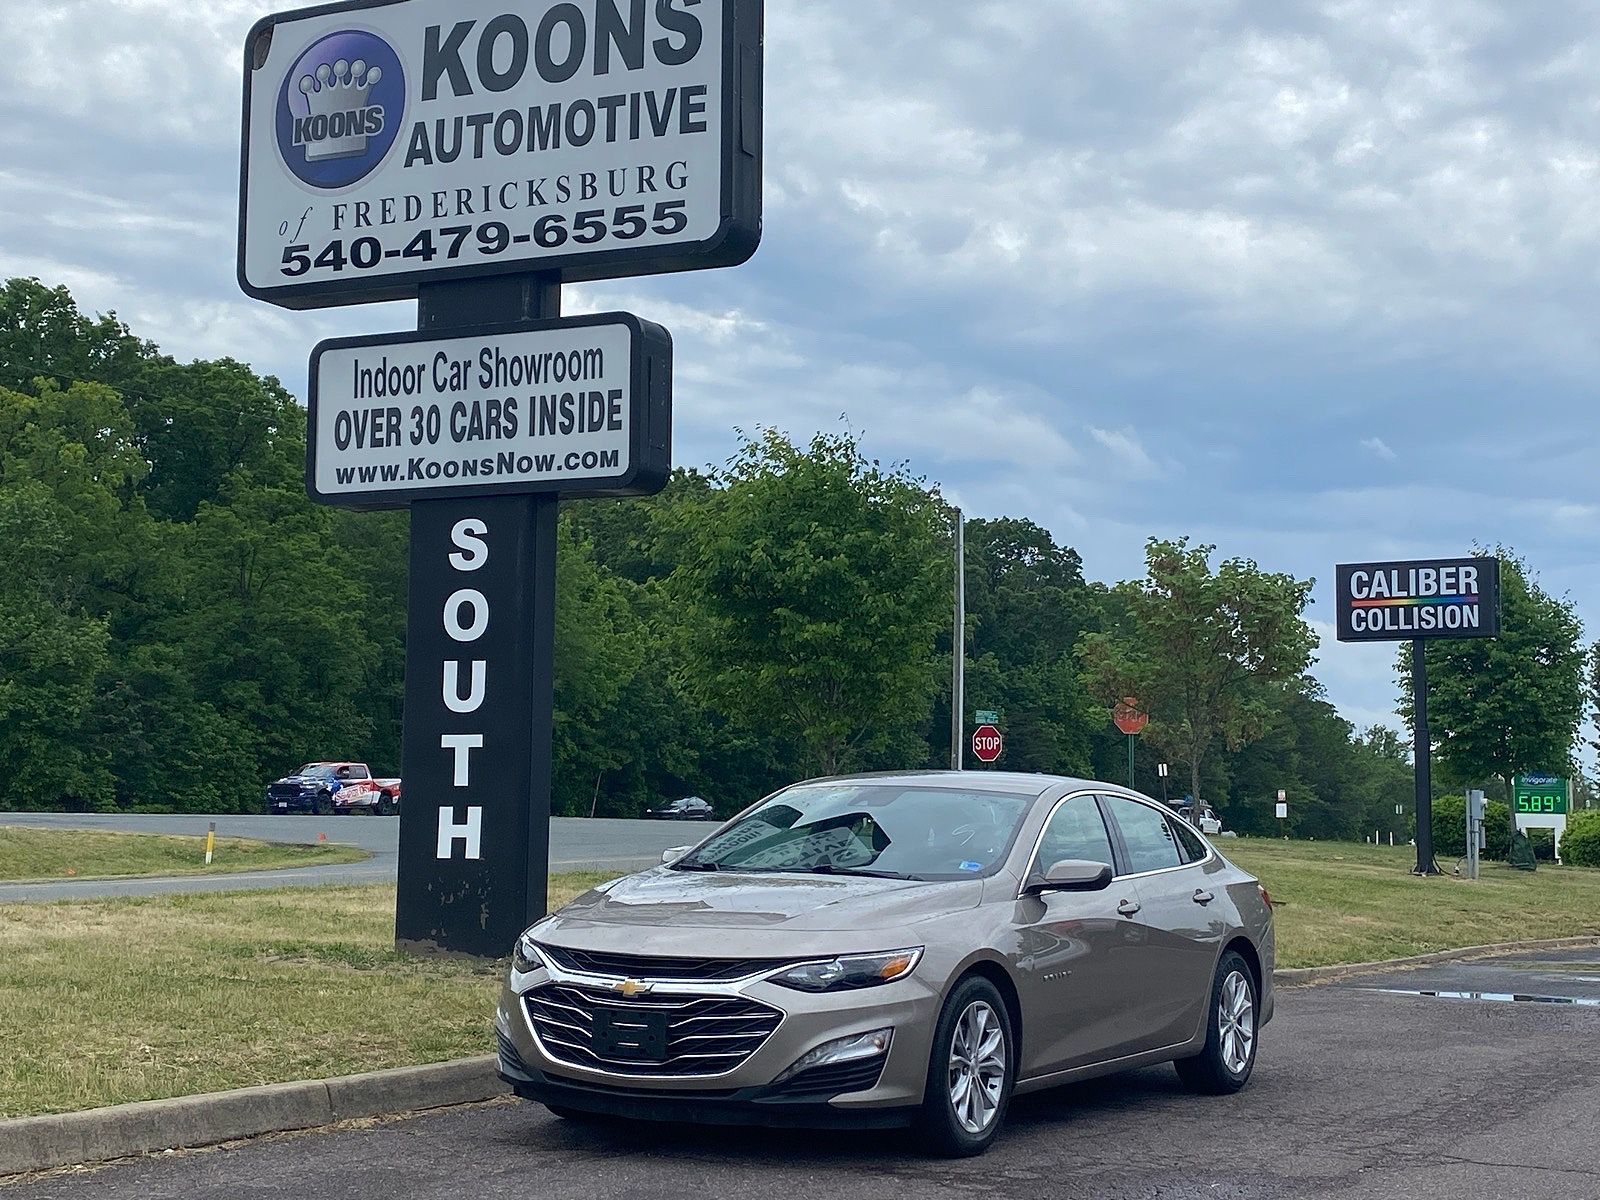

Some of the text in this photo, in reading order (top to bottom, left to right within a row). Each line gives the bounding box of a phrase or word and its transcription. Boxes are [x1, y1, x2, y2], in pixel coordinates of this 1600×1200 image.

[421, 0, 703, 101] KOONS
[294, 107, 383, 143] KOONS
[403, 84, 707, 168] AUTOMOTIVE
[278, 160, 689, 243] of FREDERICKSBURG
[280, 200, 688, 277] 540-479-6555
[353, 347, 603, 399] Indoor Car Showroom
[334, 389, 623, 451] OVER 30 CARS INSIDE
[1350, 566, 1479, 599] CALIBER
[1351, 605, 1479, 632] COLLISION
[436, 518, 489, 859] SOUTH
[975, 737, 1000, 750] STOP
